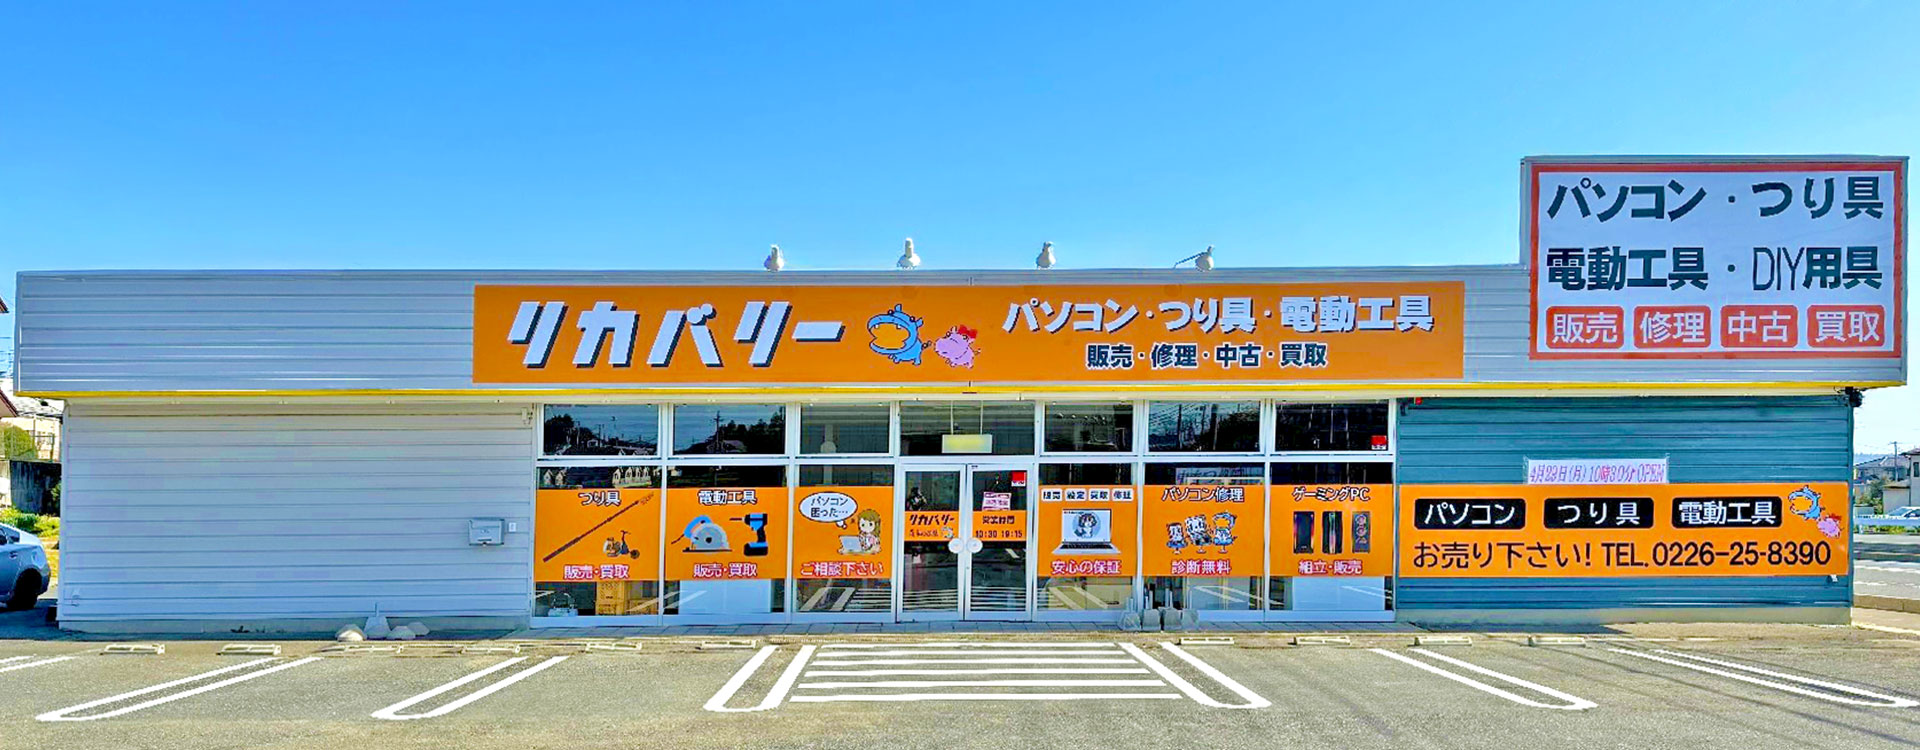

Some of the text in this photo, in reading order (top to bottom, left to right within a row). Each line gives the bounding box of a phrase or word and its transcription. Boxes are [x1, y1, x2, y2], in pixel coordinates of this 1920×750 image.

[507, 301, 846, 368] リカバリー
[1552, 311, 1880, 343] 販売 修理 中古 買取
[579, 491, 621, 506] つり具
[698, 490, 758, 505] 電動工具
[1162, 486, 1244, 502] パソコン修理
[1292, 486, 1370, 501] ゲーミングPC
[811, 496, 849, 507] パソコン
[909, 514, 955, 526] リカバリー
[1424, 500, 1776, 525] パソコン つり具 電動工具
[563, 564, 629, 579] 販売・買取
[693, 563, 758, 578] 販売・買取
[800, 561, 883, 577] ご相談下さい
[1051, 560, 1121, 575] 安心の保証
[1171, 559, 1231, 575] 診断無料
